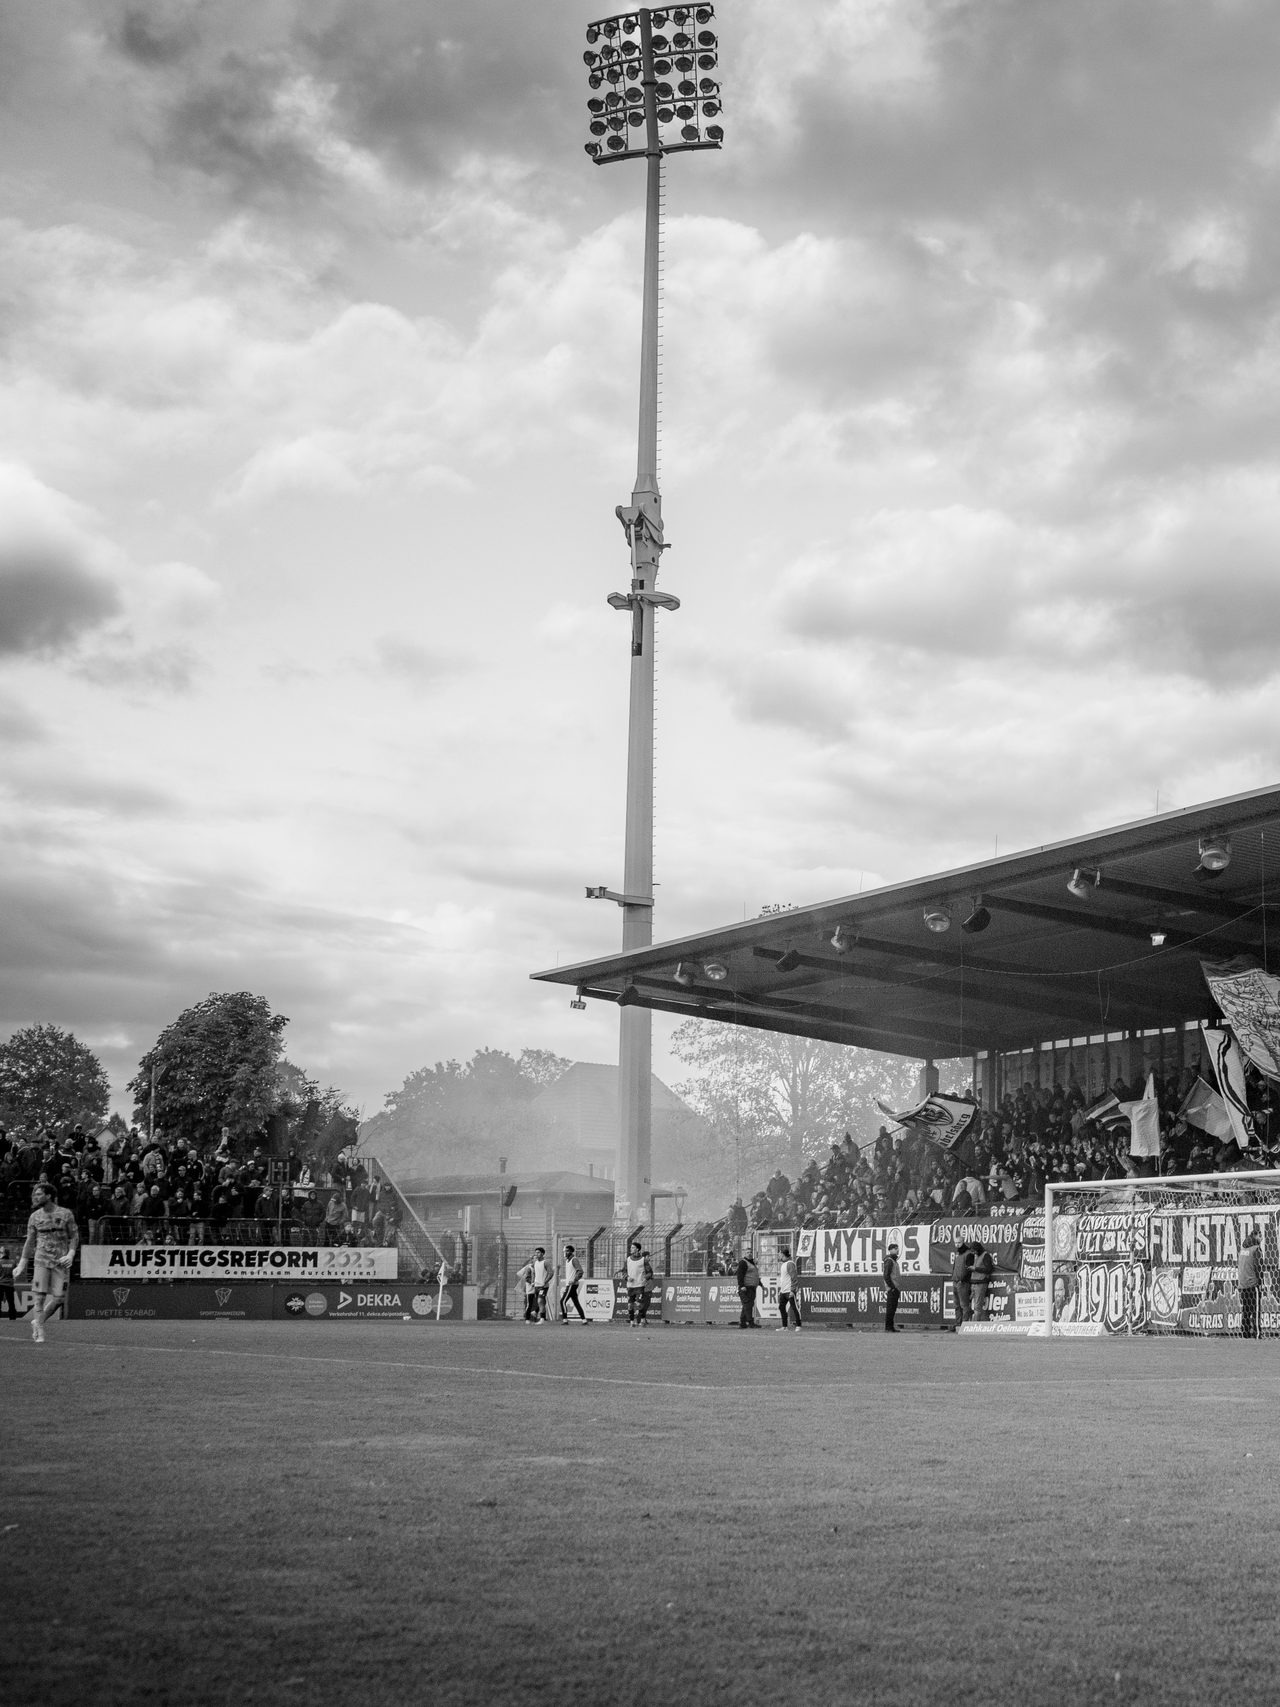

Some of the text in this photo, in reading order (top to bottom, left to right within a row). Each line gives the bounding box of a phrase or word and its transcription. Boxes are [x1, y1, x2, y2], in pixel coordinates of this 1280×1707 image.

[932, 1225, 952, 1243] LOS
[1150, 1215, 1270, 1262] FILMSTADT
[109, 1250, 318, 1268] AUFSTIEGSREFORM
[824, 1261, 920, 1274] BABELSRG
[357, 1294, 401, 1306] DEKRA
[803, 1287, 928, 1303] WESTMINSTER WESINSTER
[963, 1325, 996, 1333] nahkauf
